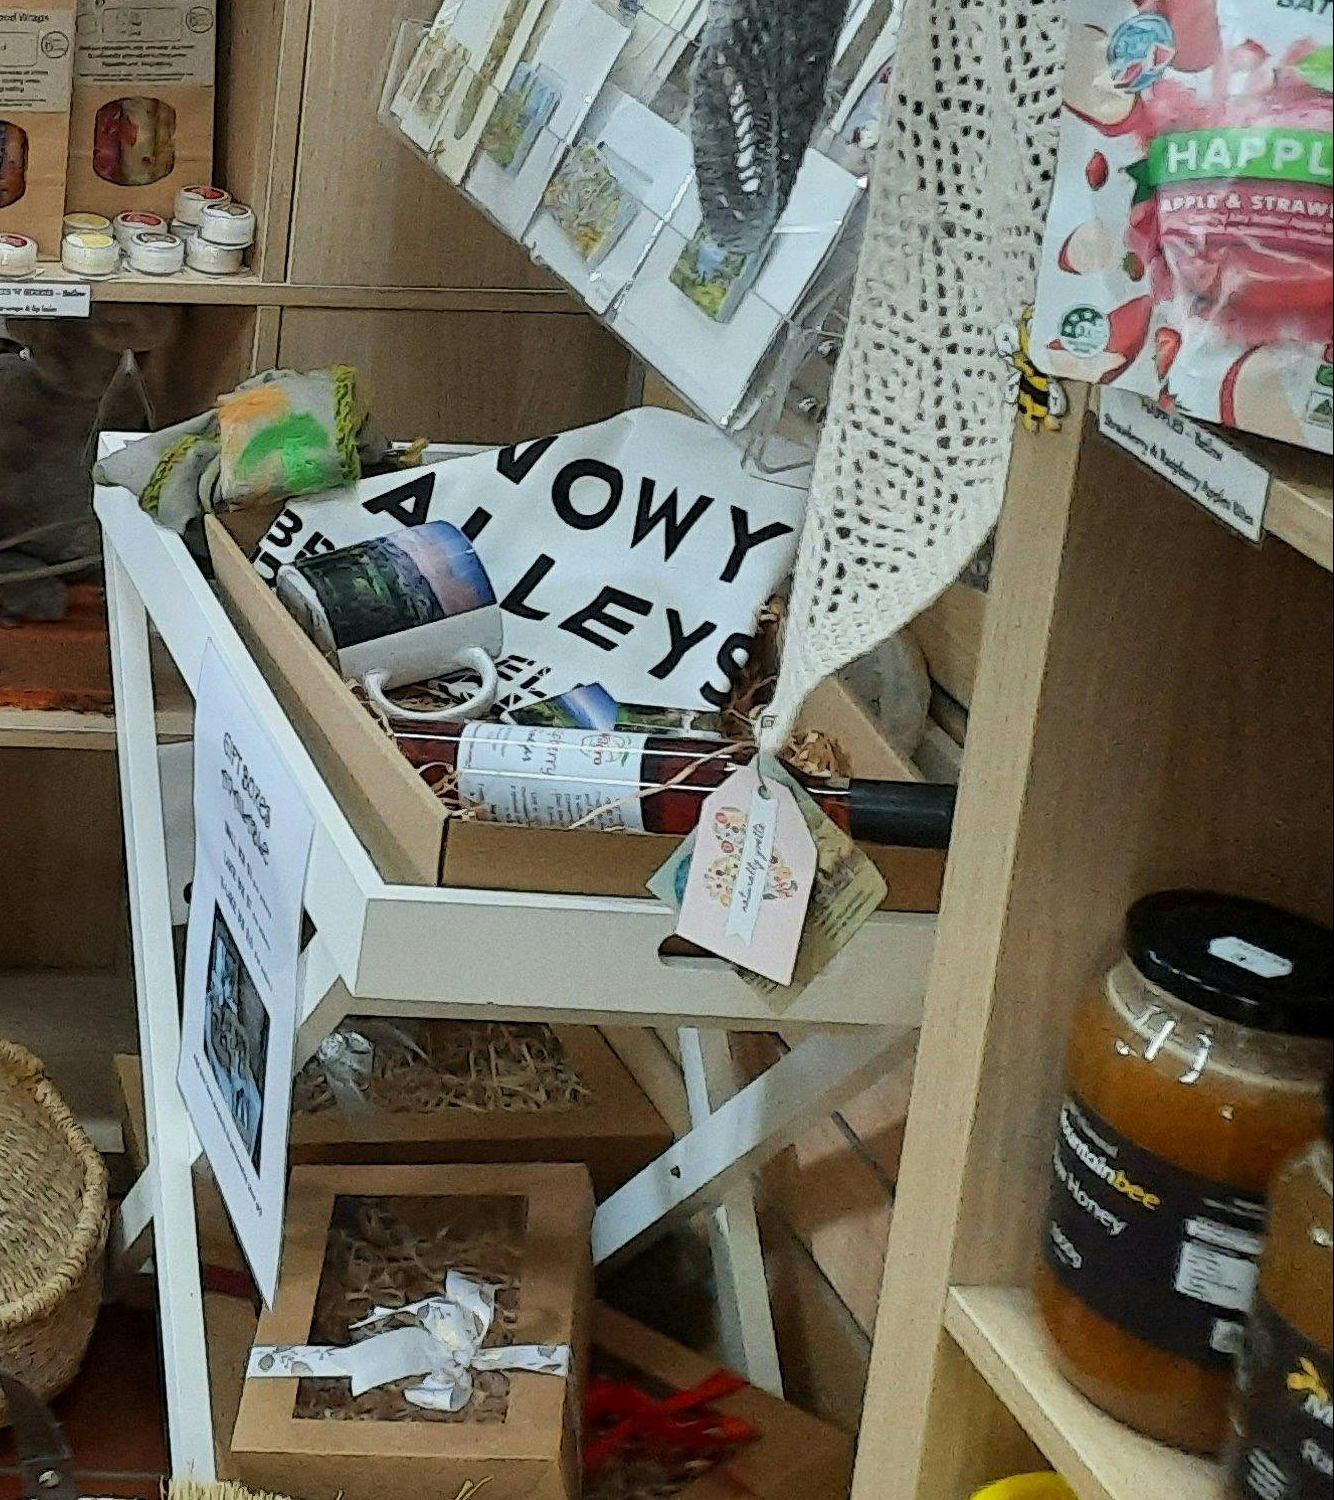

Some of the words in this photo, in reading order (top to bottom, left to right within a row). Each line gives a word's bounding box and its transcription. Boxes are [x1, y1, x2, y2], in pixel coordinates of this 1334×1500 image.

[18, 13, 50, 25] Wraps
[1166, 136, 1332, 177] HAPPL
[1160, 193, 1219, 214] APPLE
[1224, 191, 1243, 211] &
[1249, 193, 1333, 220] STRAW
[1067, 1171, 1129, 1237] Honey
